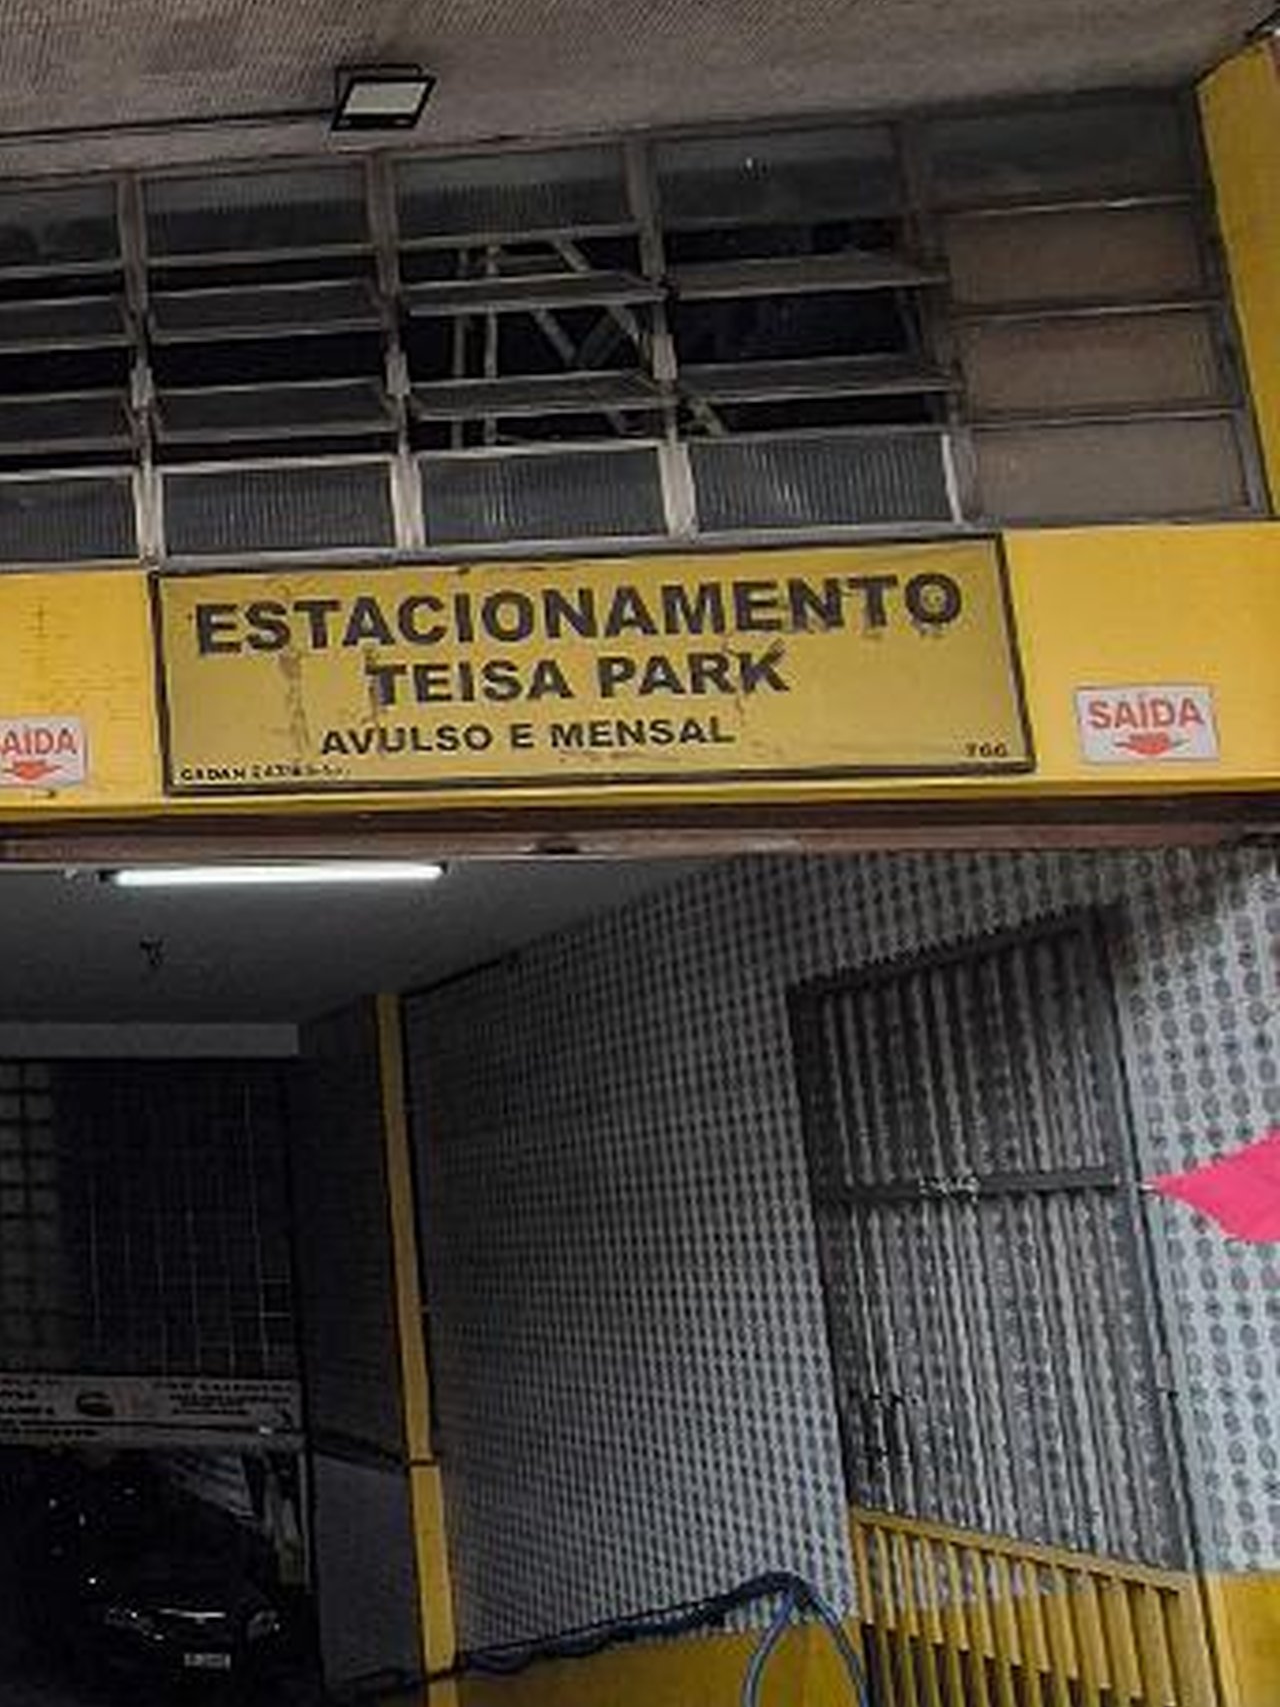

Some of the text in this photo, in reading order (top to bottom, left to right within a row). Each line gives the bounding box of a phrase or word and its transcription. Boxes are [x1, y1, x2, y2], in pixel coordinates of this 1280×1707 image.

[195, 572, 963, 655] ESTACIONAMENTO
[365, 640, 790, 706] TEISA PARK
[320, 716, 737, 756] AVULSO E MENSAL
